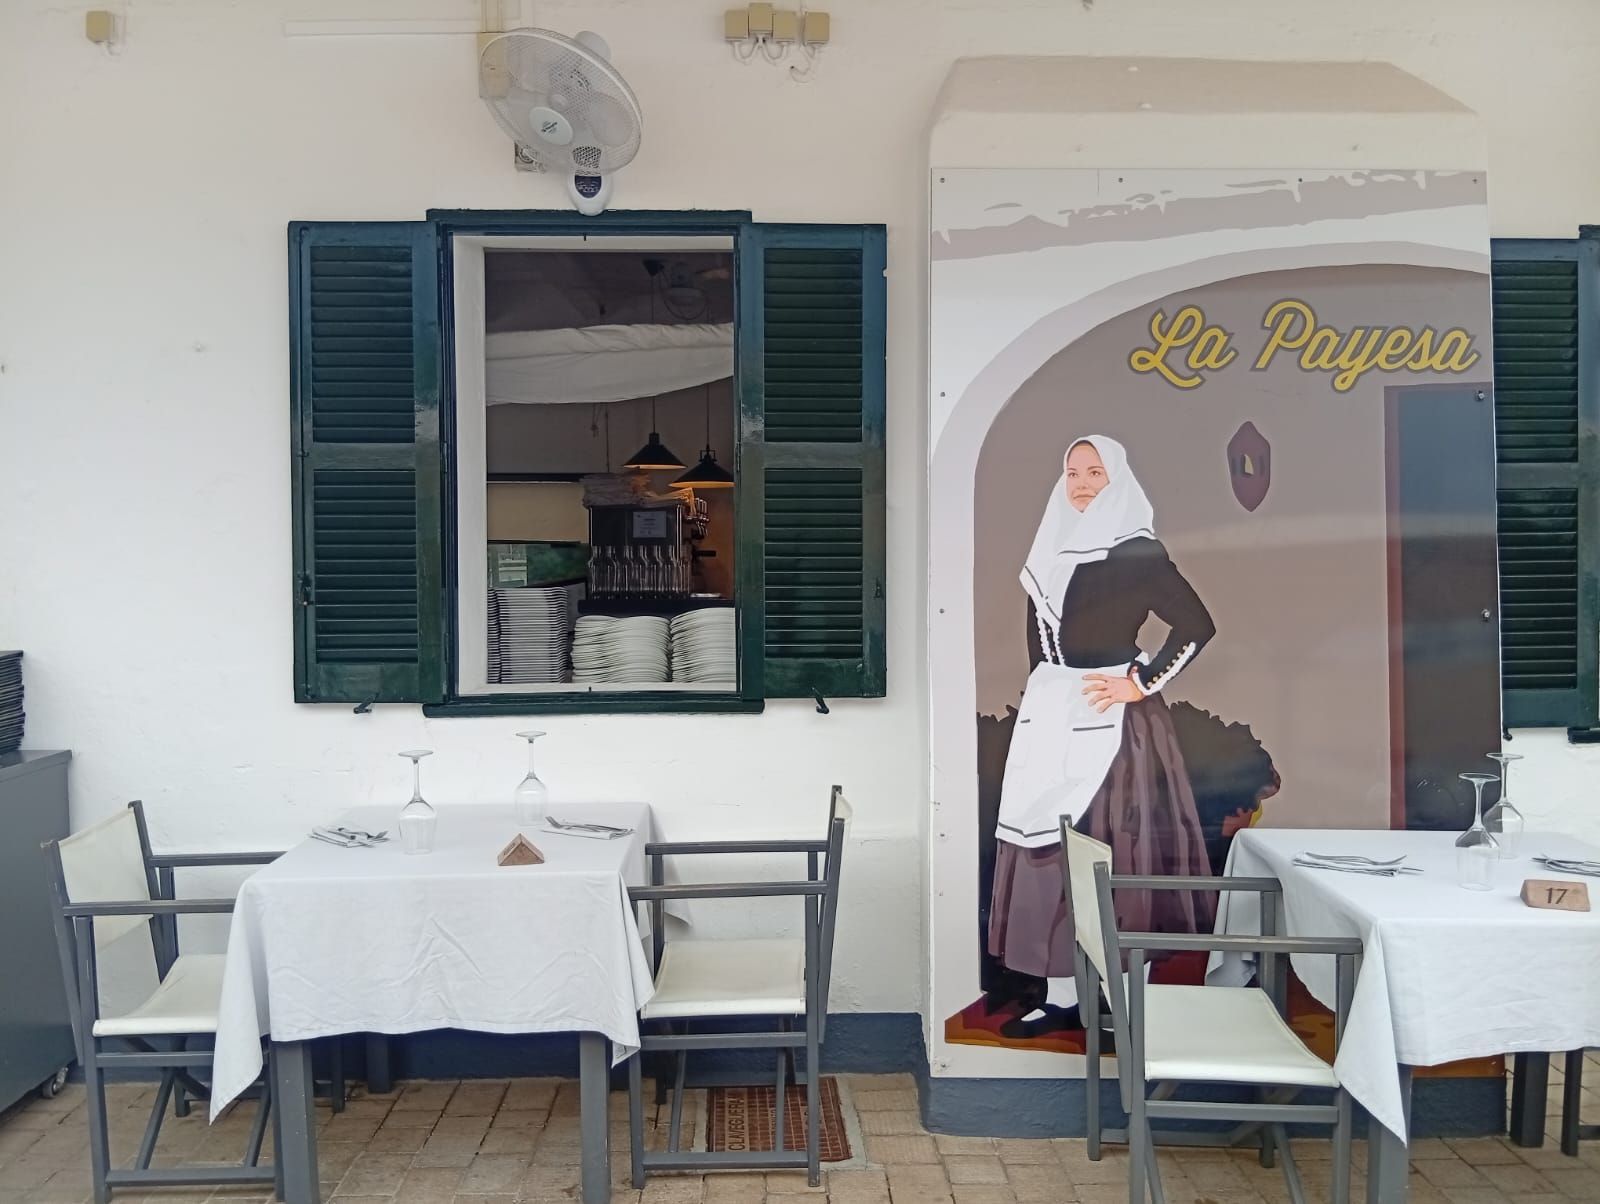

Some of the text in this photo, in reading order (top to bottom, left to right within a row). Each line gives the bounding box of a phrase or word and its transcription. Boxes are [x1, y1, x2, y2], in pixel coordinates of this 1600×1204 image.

[1128, 298, 1481, 392] La Payesa
[1545, 887, 1569, 905] 17
